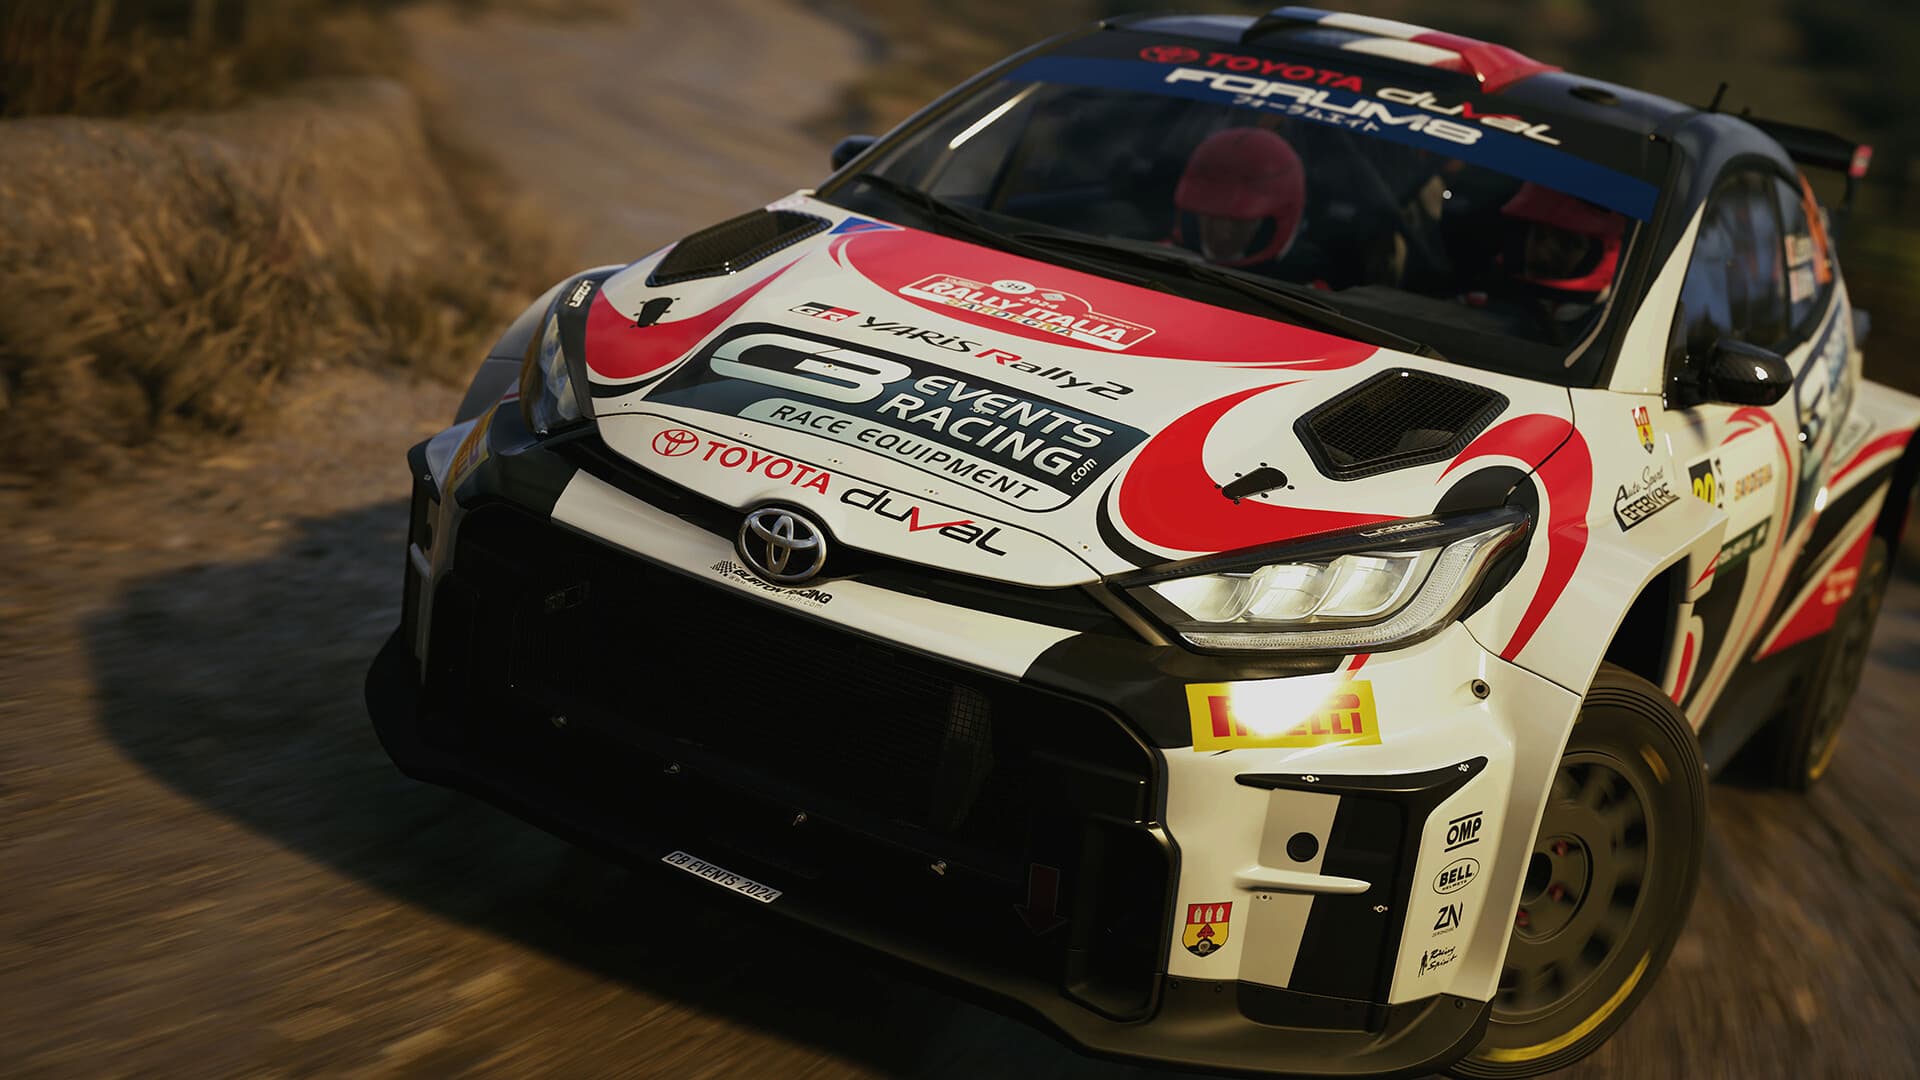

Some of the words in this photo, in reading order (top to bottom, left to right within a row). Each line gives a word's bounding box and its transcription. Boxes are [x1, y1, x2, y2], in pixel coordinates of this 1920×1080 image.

[1207, 52, 1363, 93] TOYOTA
[1165, 67, 1483, 146] FORUM8
[921, 282, 1024, 310] RALLY
[1022, 307, 1127, 342] ITALIA
[876, 392, 1085, 478] RACING
[912, 376, 1115, 448] EVENTS
[702, 441, 831, 495] TOYOTA
[773, 403, 846, 435] RACE
[857, 429, 1039, 500] EQUIPMENT
[1446, 817, 1482, 845] OMP
[687, 861, 740, 886] EVENTS
[737, 881, 777, 900] 2024
[1439, 864, 1472, 887] BELL
